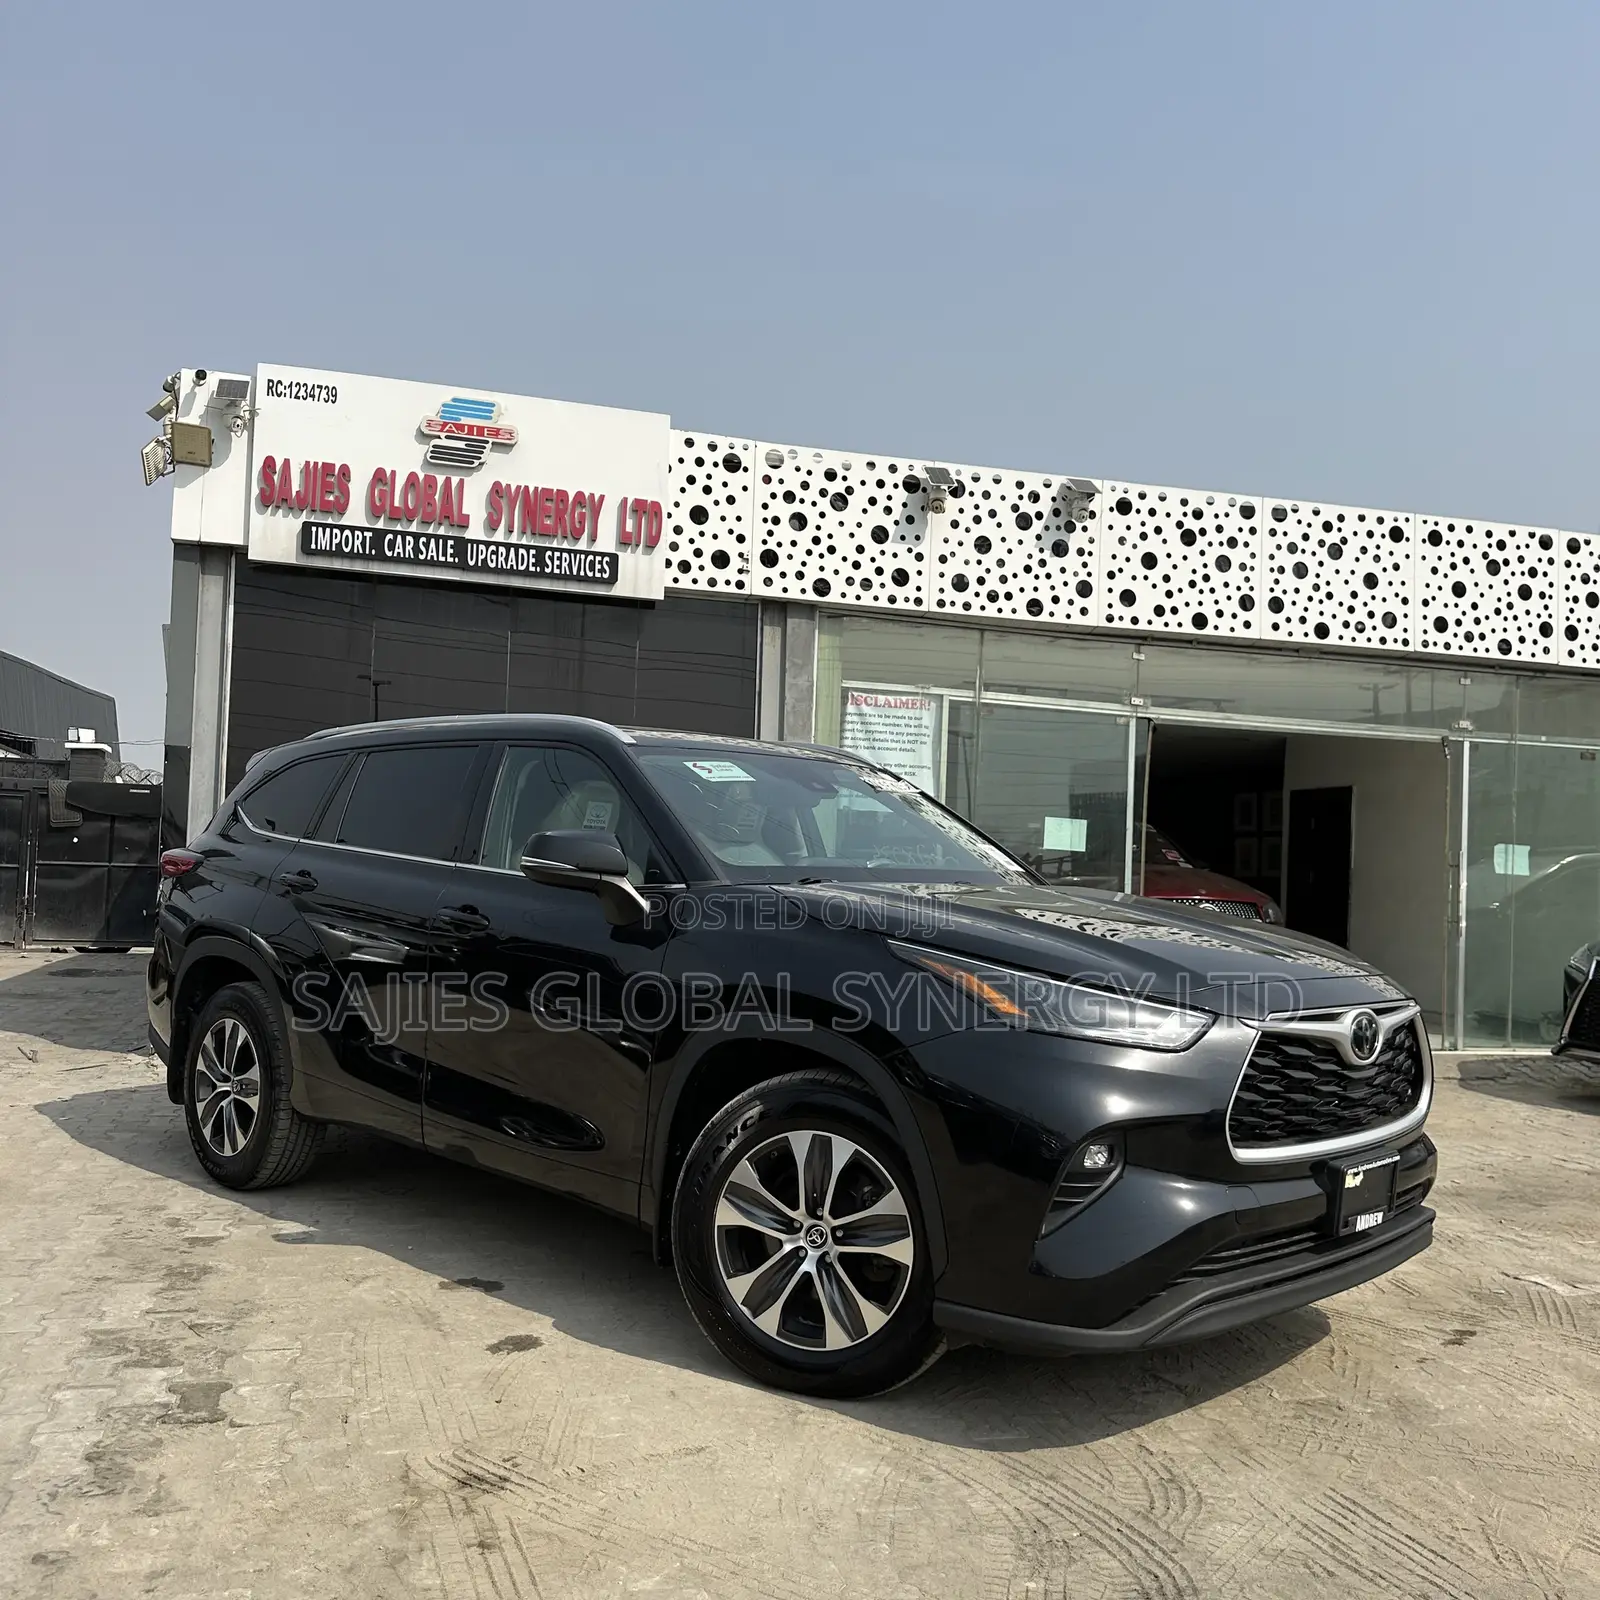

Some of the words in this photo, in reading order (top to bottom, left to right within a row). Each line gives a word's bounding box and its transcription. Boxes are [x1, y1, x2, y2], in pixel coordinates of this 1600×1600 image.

[267, 379, 338, 404] RC:1234739
[425, 419, 516, 440] SAJIES
[260, 455, 351, 515] SAJIES
[369, 467, 471, 528] GLOBAL
[487, 480, 606, 541] SYNERGY
[619, 496, 663, 548] LTD
[310, 526, 376, 556] IMPORT.
[384, 533, 414, 558] CAR
[418, 537, 459, 563] SALE.
[467, 542, 541, 573] UPGRADE.
[544, 552, 610, 579] SERVICES
[849, 693, 931, 711] ISCLAIMER!
[1355, 1211, 1384, 1232] ANDREW
